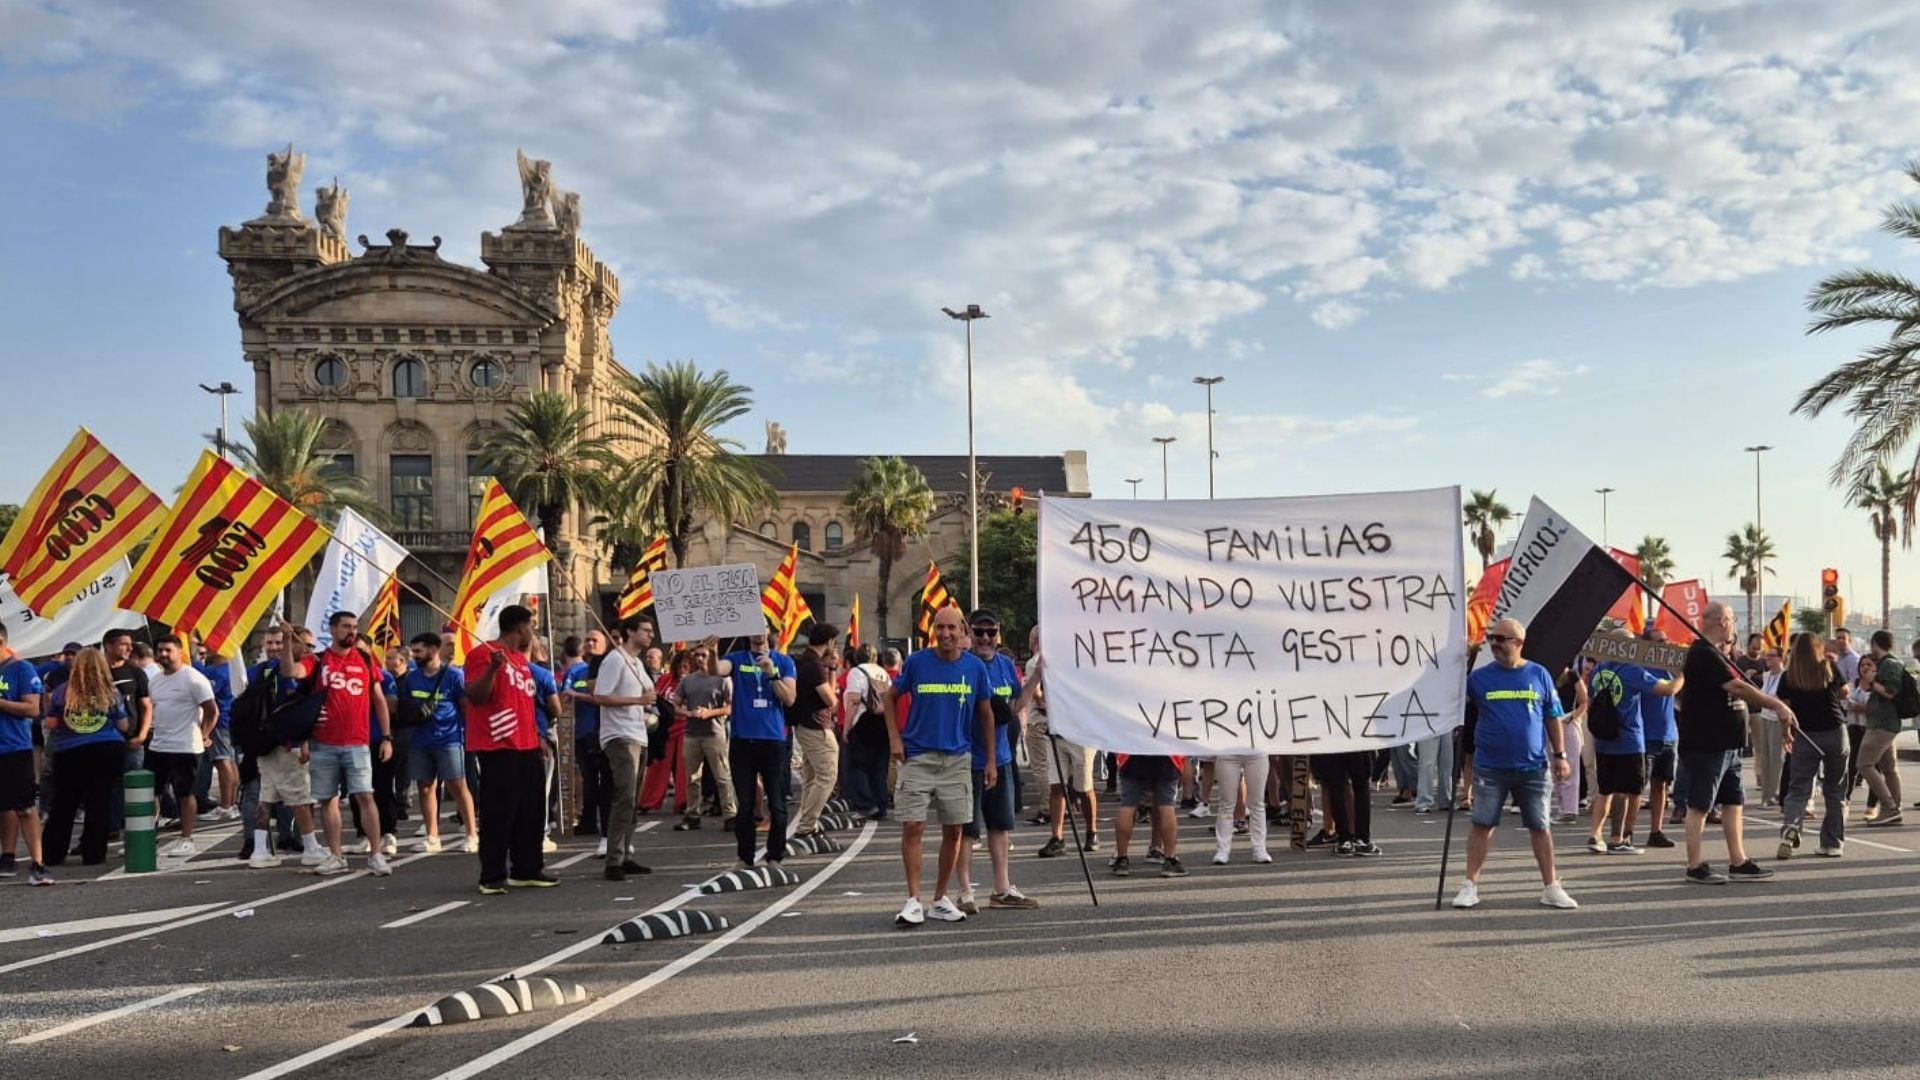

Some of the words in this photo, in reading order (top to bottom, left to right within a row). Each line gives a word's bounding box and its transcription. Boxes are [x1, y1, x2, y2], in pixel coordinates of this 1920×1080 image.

[1069, 522, 1152, 563] 450
[651, 573, 684, 596] NO
[690, 575, 713, 592] AL
[717, 569, 757, 591] PLAN
[1071, 574, 1254, 614] PAGANDO
[1279, 574, 1457, 613] VUESTRA
[655, 597, 676, 613] DE
[673, 612, 696, 626] DE
[704, 606, 741, 625] APB
[1074, 628, 1257, 670] NEFASTA
[1598, 638, 1638, 660] PASO
[1644, 646, 1684, 667] ATRA
[1138, 689, 1441, 750] VERGÜENZA
